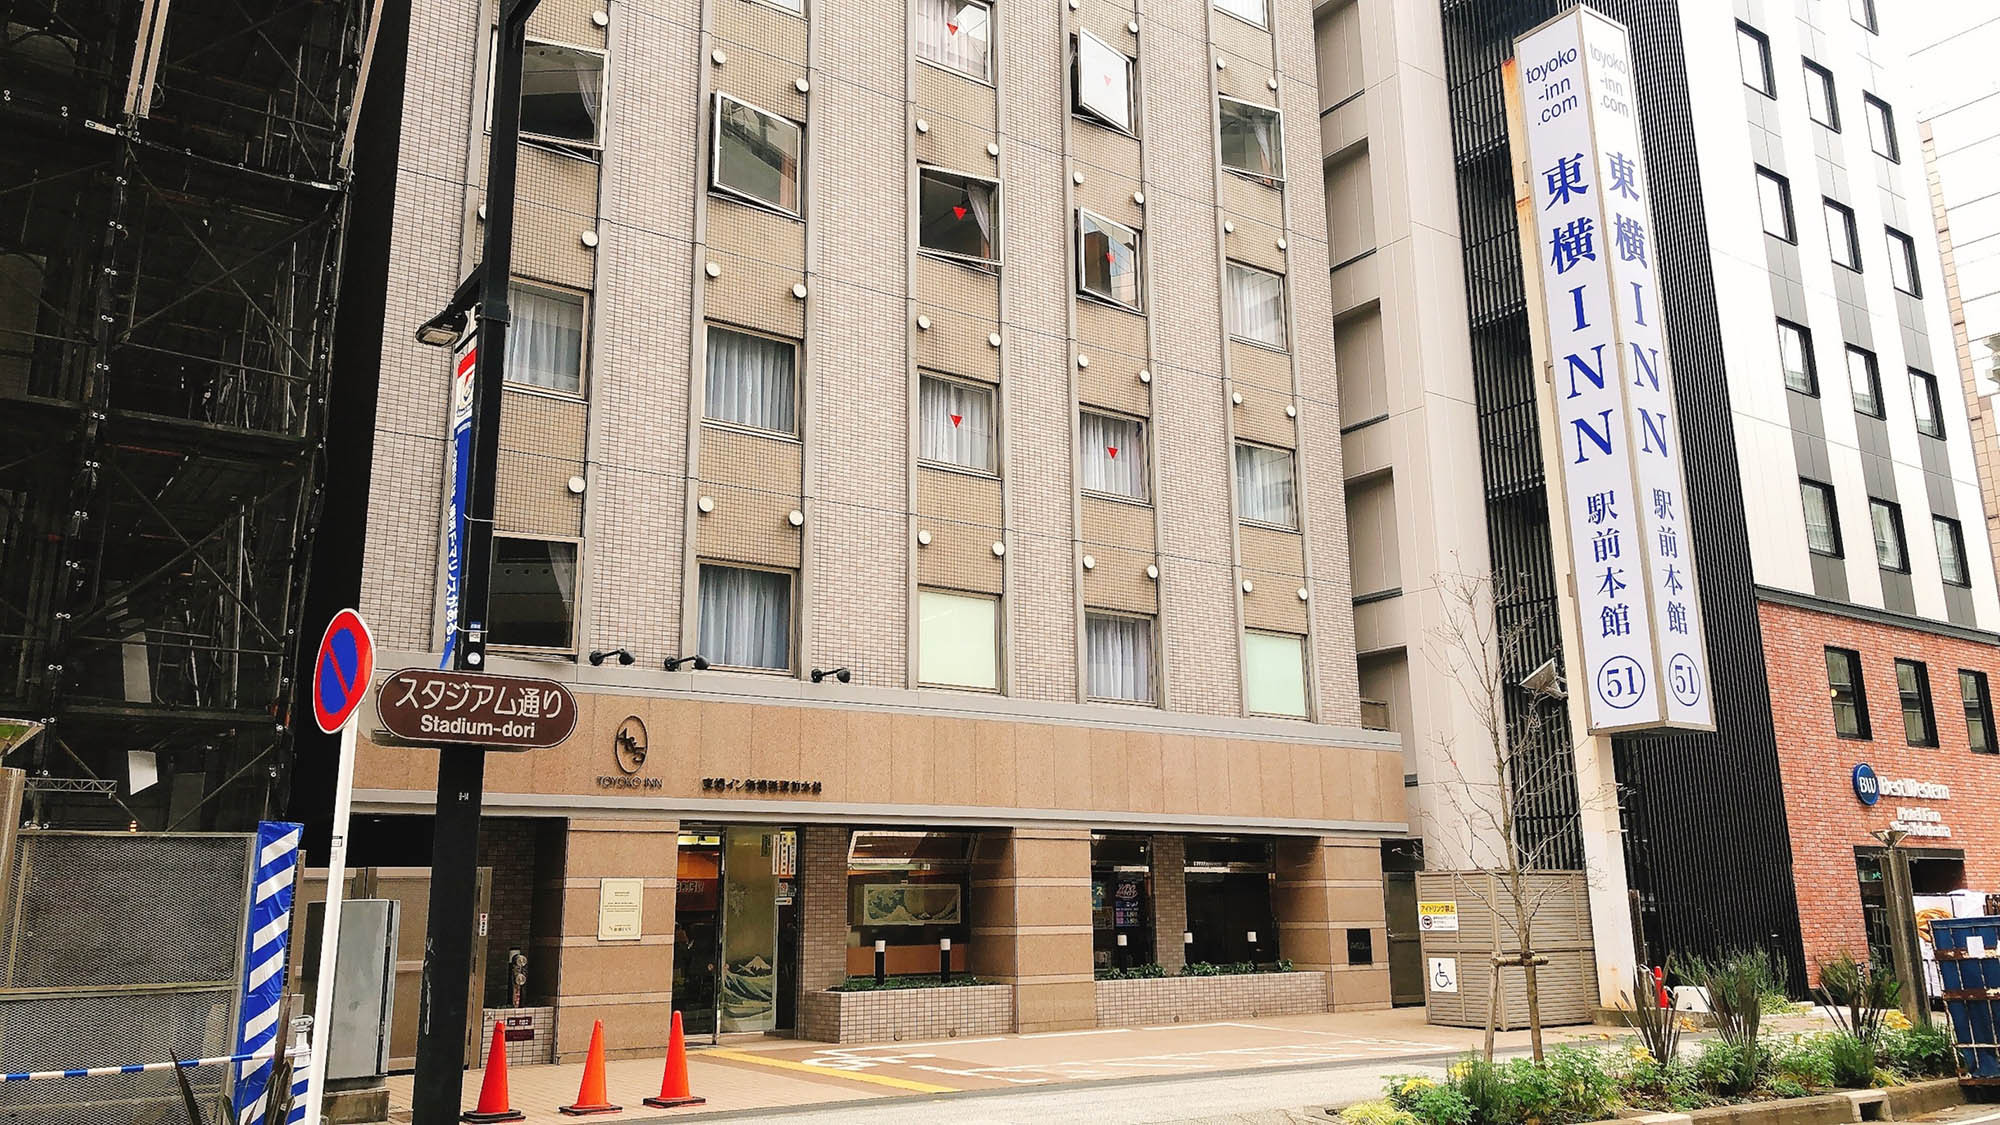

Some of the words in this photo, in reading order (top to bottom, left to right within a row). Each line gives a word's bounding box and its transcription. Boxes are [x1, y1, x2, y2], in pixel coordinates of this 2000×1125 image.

[1526, 48, 1577, 84] toyoko
[1590, 43, 1626, 74] toyoko
[1538, 77, 1571, 101] -inn
[1600, 72, 1623, 97] -inn
[1537, 94, 1578, 126] .com
[1600, 95, 1629, 118] .com
[1586, 489, 1631, 639] 駅前本館
[1652, 487, 1688, 635] 駅前本館
[1606, 666, 1638, 698] 51
[1673, 665, 1697, 695] 51
[395, 678, 562, 718] スタジアム通り
[420, 714, 536, 739] Stadium-dori
[597, 775, 642, 789] TOYOKO
[643, 777, 663, 790] INN
[1859, 776, 1877, 794] BW
